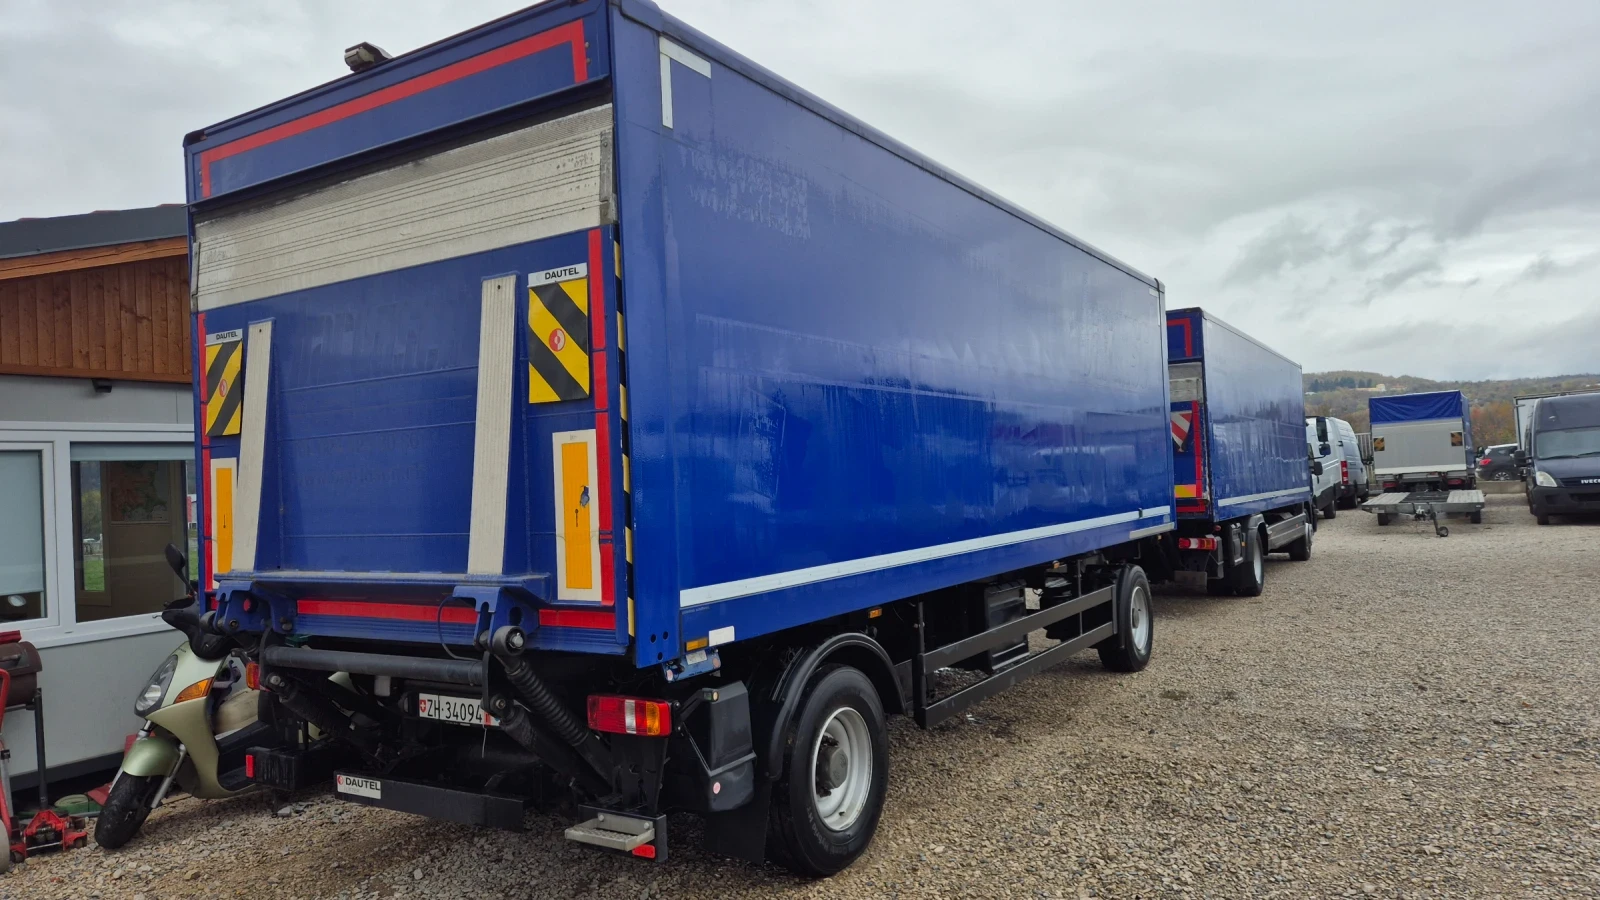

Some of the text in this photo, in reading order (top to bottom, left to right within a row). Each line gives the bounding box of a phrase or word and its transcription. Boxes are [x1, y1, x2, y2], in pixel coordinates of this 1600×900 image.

[544, 267, 579, 280] DAUTEL
[216, 331, 238, 340] DAUTEL
[345, 777, 381, 791] DAUTEL
